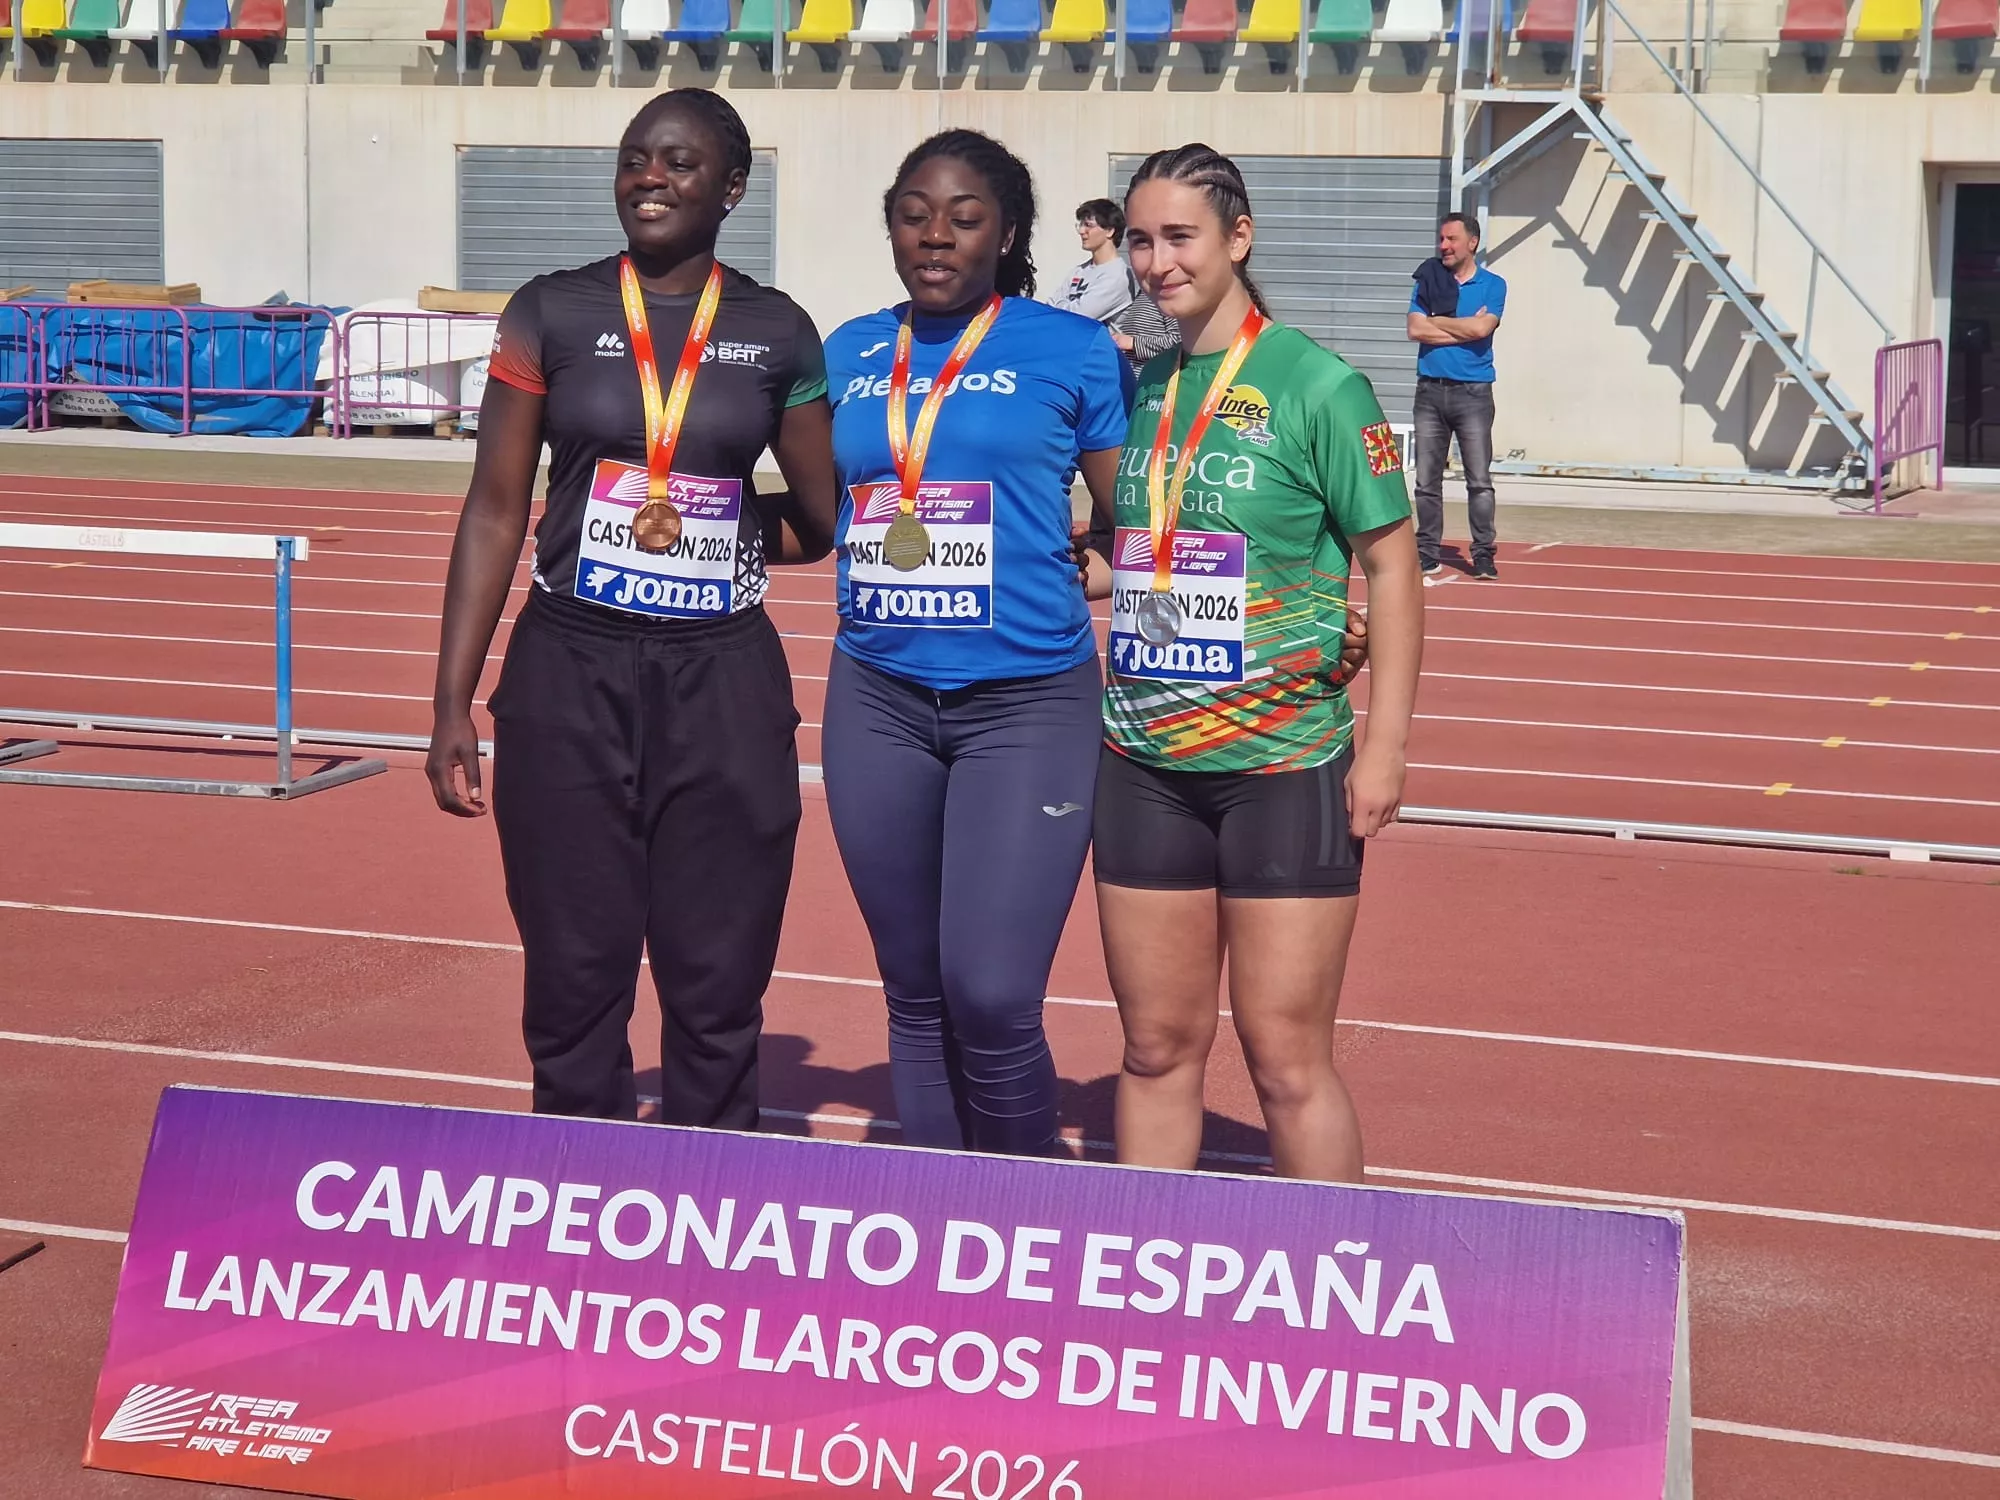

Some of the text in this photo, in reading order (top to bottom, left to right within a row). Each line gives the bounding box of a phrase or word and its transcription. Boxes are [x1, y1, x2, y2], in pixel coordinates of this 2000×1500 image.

[718, 347, 761, 363] BAT
[1217, 388, 1271, 419] intec
[671, 480, 719, 495] RFEA
[915, 487, 952, 500] FEA
[691, 506, 723, 517] LIBRE
[914, 500, 975, 509] LETISMO
[925, 511, 965, 520] LIBRE
[697, 537, 732, 562] 2026
[849, 541, 936, 567] CASTN
[941, 542, 987, 567] 2026
[1172, 537, 1206, 548] FEA
[1172, 550, 1227, 561] LETISMO
[1181, 562, 1218, 573] LIBRE
[1194, 594, 1239, 621] 2026
[296, 1160, 1456, 1344] CAMPEONATO DE ESPAÑA
[163, 1250, 1588, 1460] LANZAMIENTOS LARGOS DE INVIERNO
[209, 1393, 300, 1420] RFEA
[197, 1416, 333, 1444] ATLETISMO
[185, 1435, 313, 1465] AIRE LIBRE
[564, 1404, 1084, 1500] CASTELLÓN 2026
